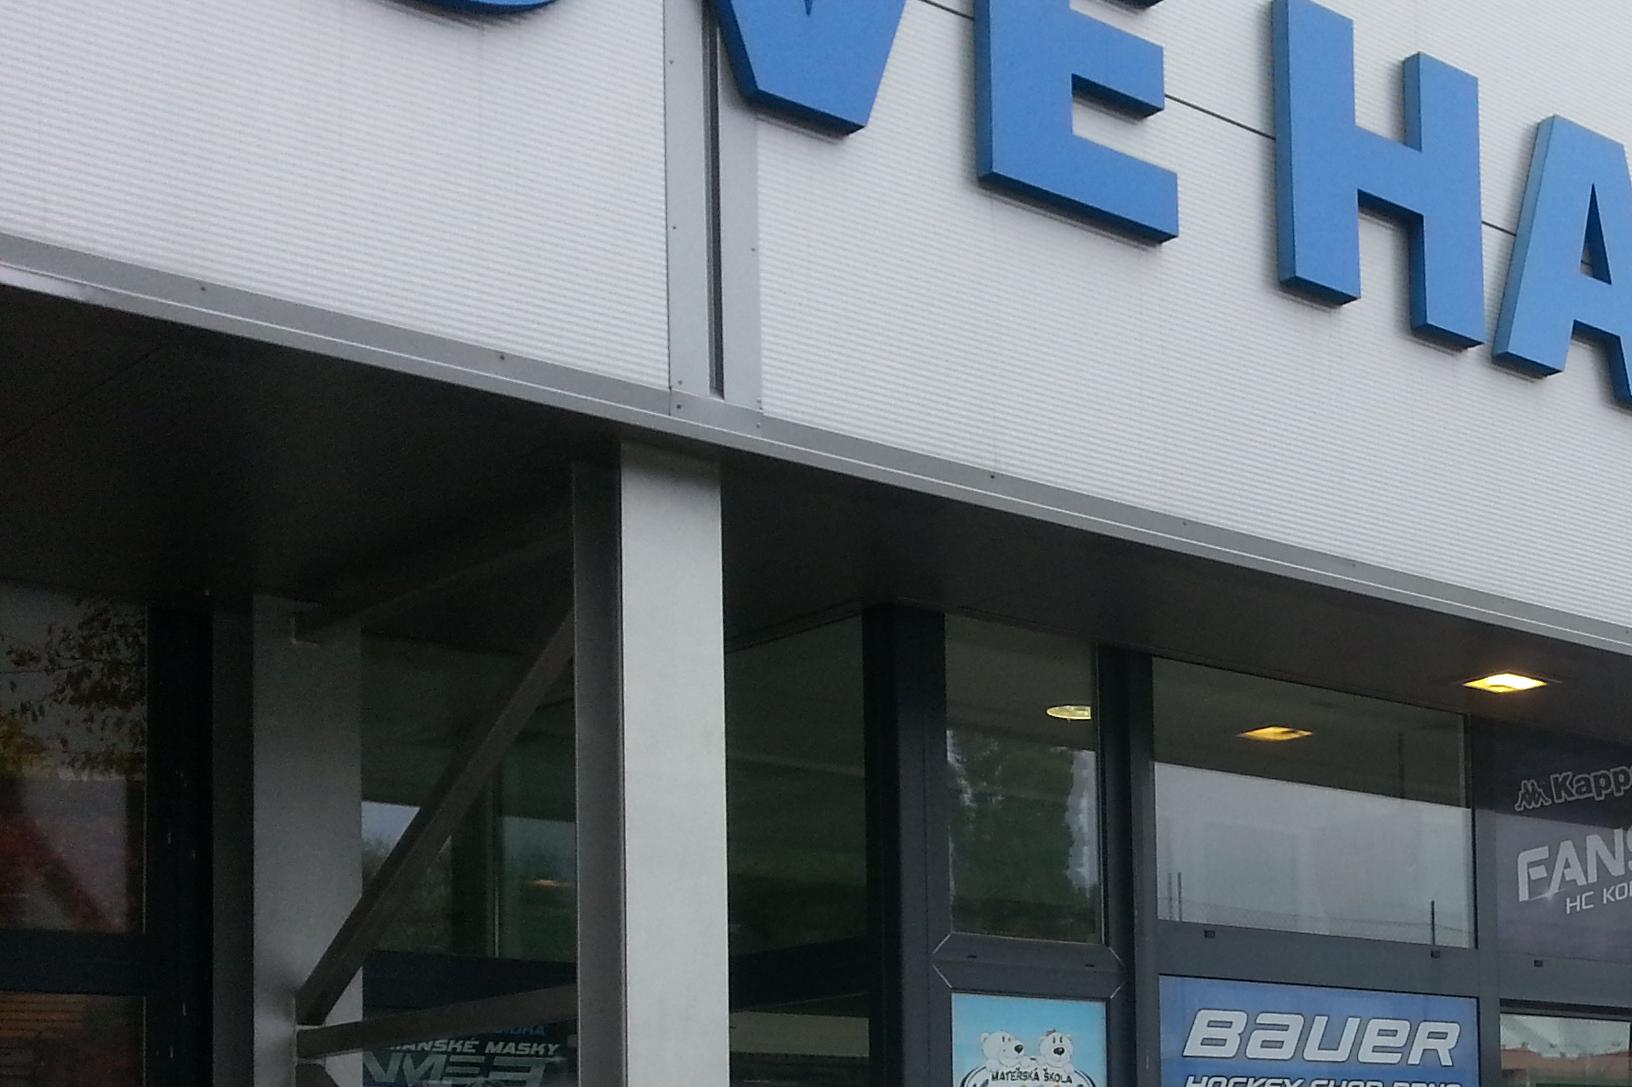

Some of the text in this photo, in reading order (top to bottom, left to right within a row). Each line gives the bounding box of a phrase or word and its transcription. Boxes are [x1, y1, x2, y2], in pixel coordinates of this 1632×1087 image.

[1565, 891, 1595, 915] HC
[485, 1041, 560, 1055] MASKY
[991, 1067, 1073, 1084] MATEŘSKÁ ŠKOLA
